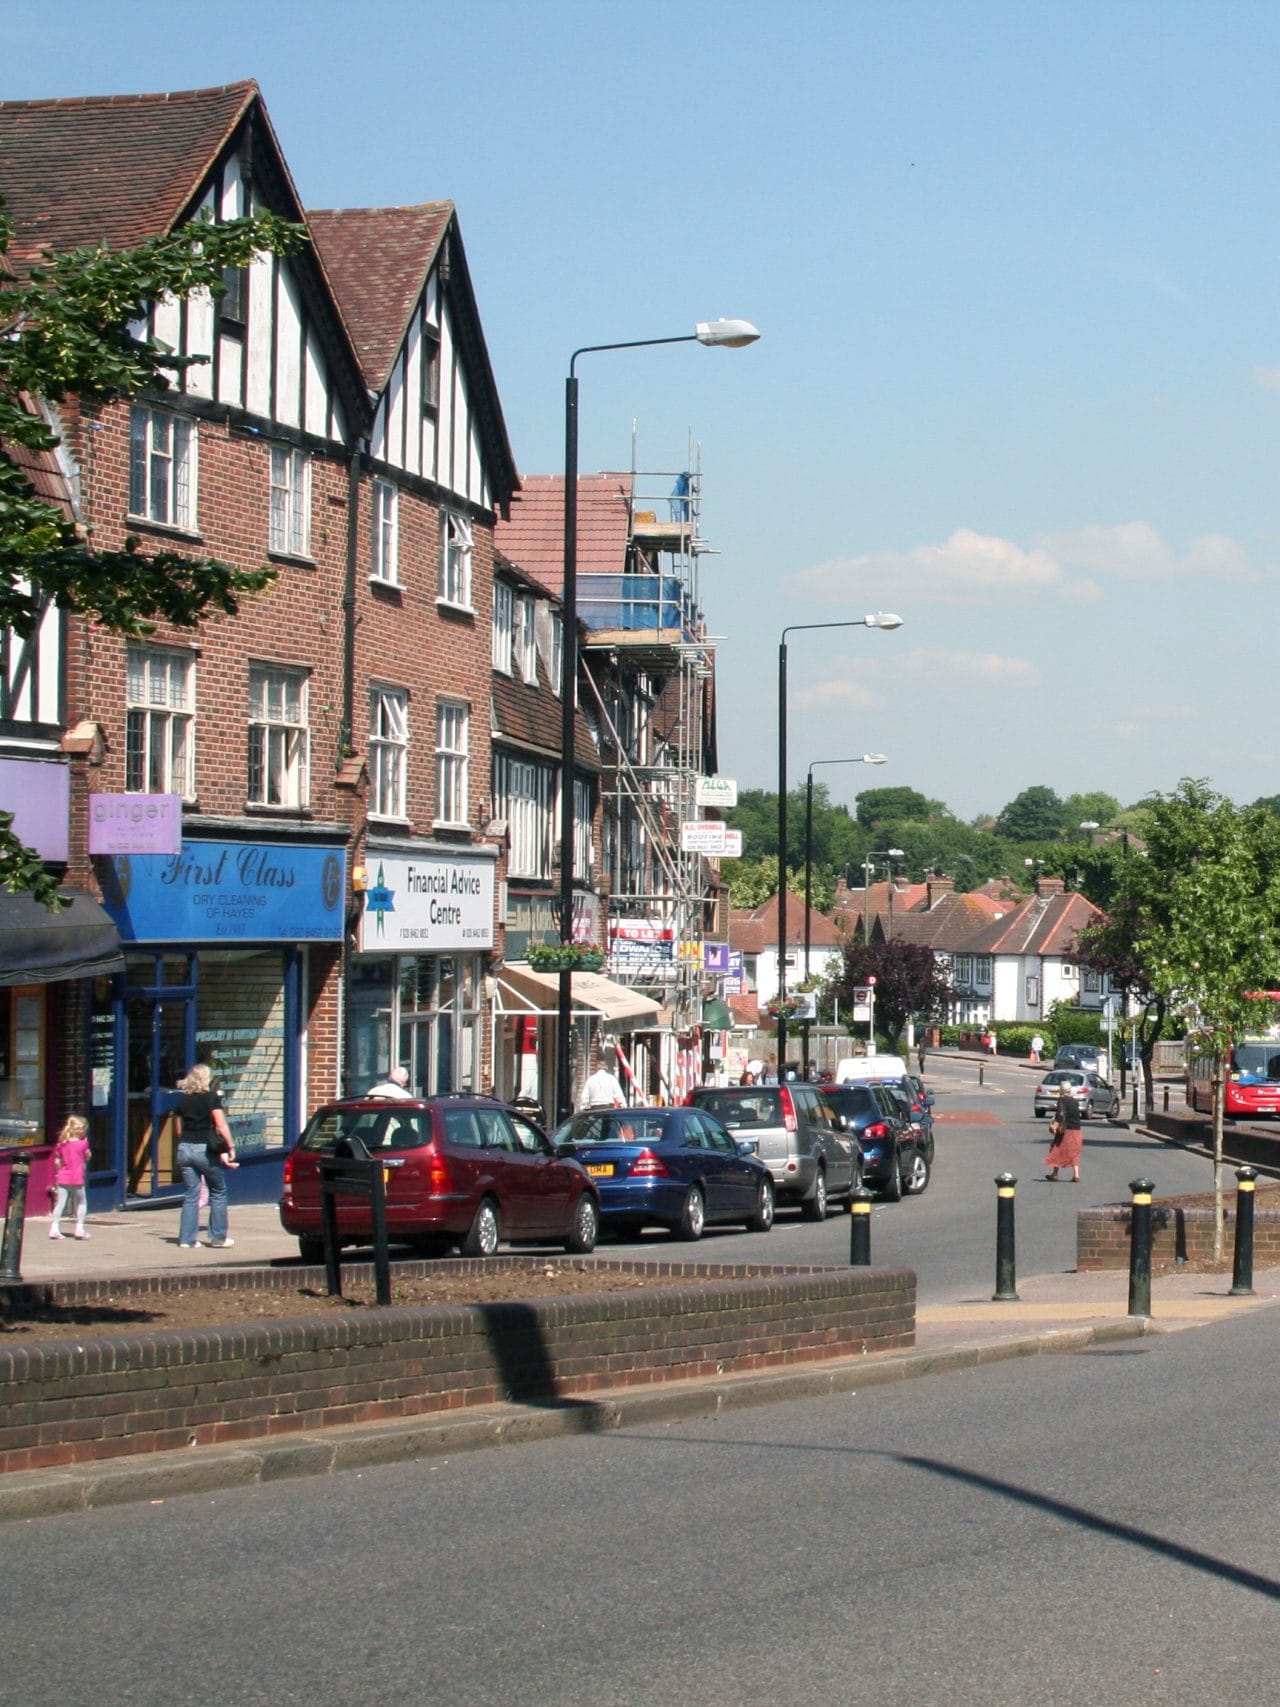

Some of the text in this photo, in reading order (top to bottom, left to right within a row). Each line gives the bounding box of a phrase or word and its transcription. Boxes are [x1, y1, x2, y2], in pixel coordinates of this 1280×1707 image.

[702, 780, 731, 790] MEGA
[94, 800, 169, 823] ginger
[161, 848, 296, 887] First Class
[408, 866, 480, 895] Financial Advice
[193, 895, 267, 906] DRY CLEANING
[207, 908, 255, 919] OF HAYES
[430, 899, 461, 924] Centre
[624, 929, 638, 938] TO
